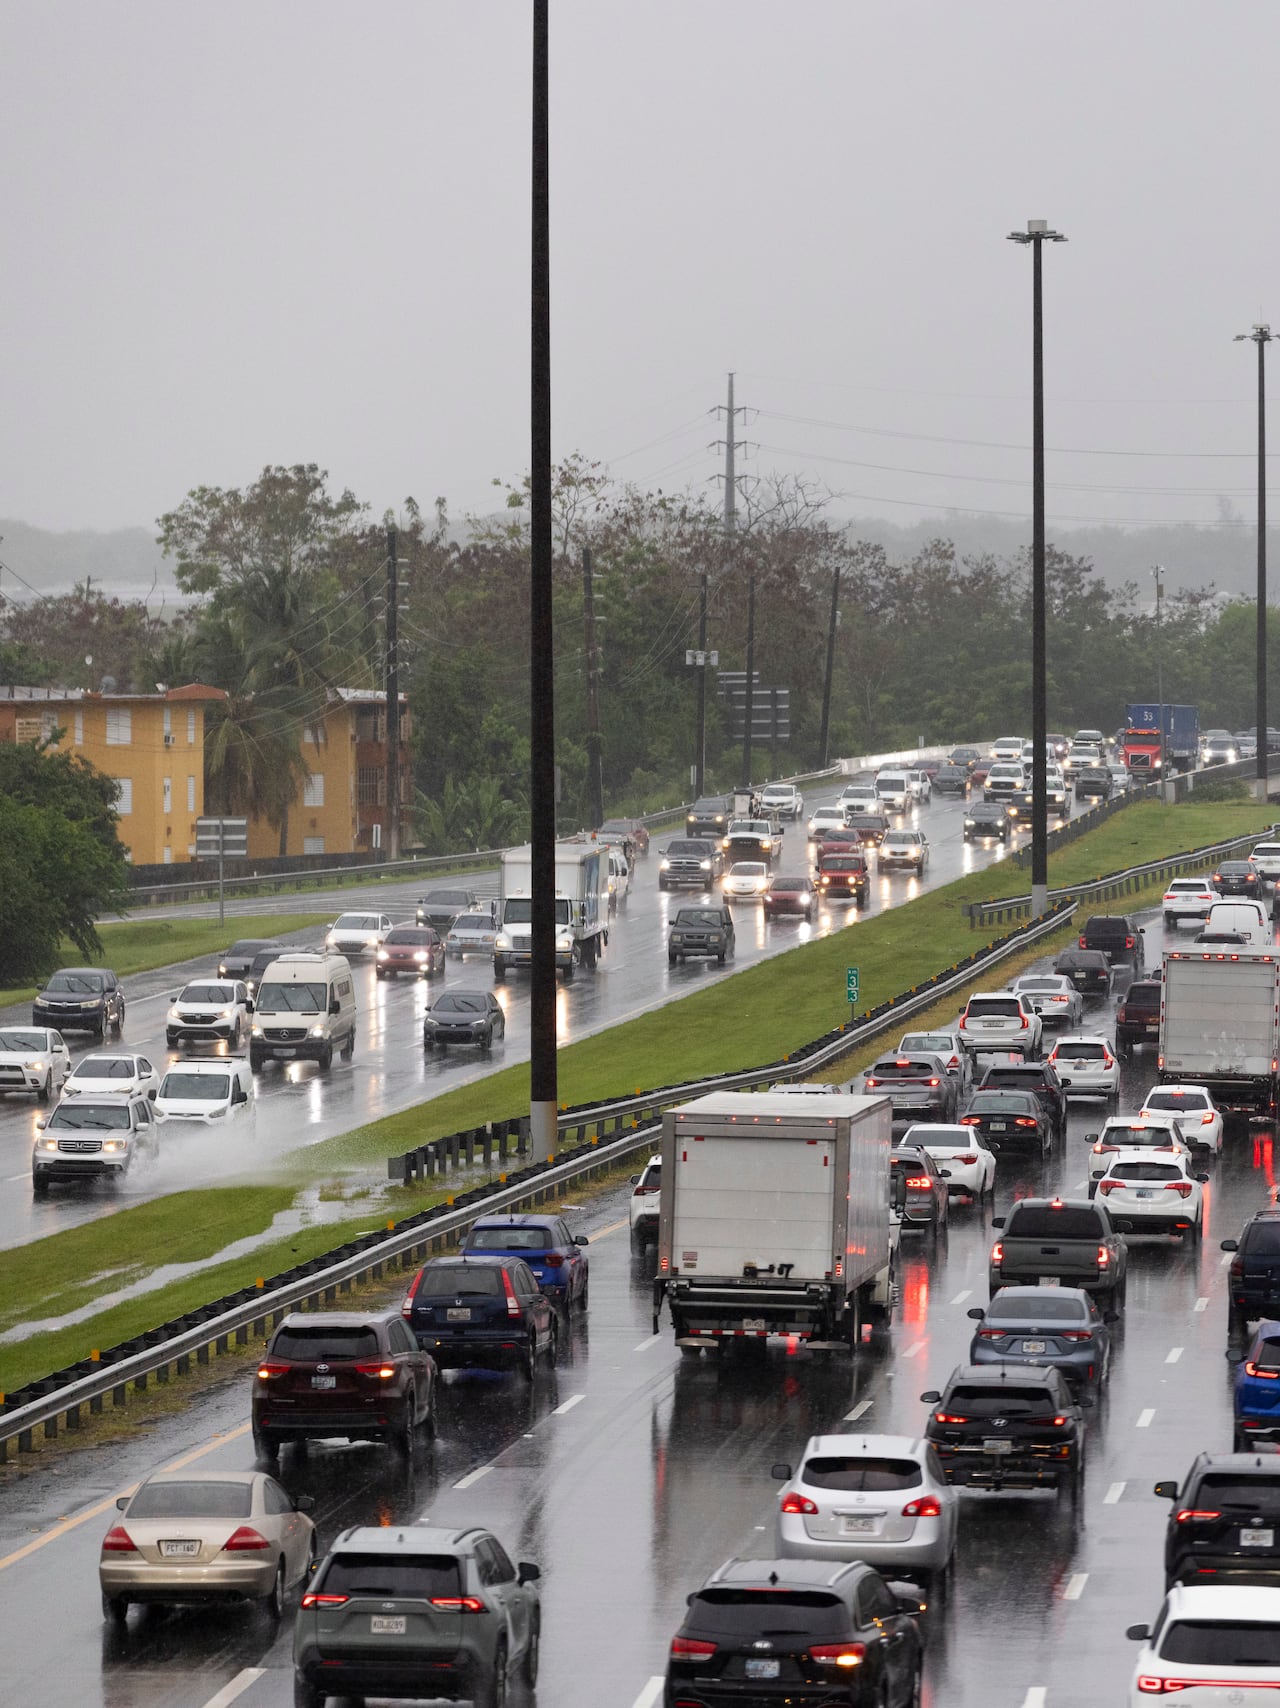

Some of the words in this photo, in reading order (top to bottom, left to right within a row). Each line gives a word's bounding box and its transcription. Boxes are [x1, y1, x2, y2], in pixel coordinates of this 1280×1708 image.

[1143, 711, 1153, 721] 53
[849, 976, 856, 987] 3
[166, 1544, 178, 1552] FCT
